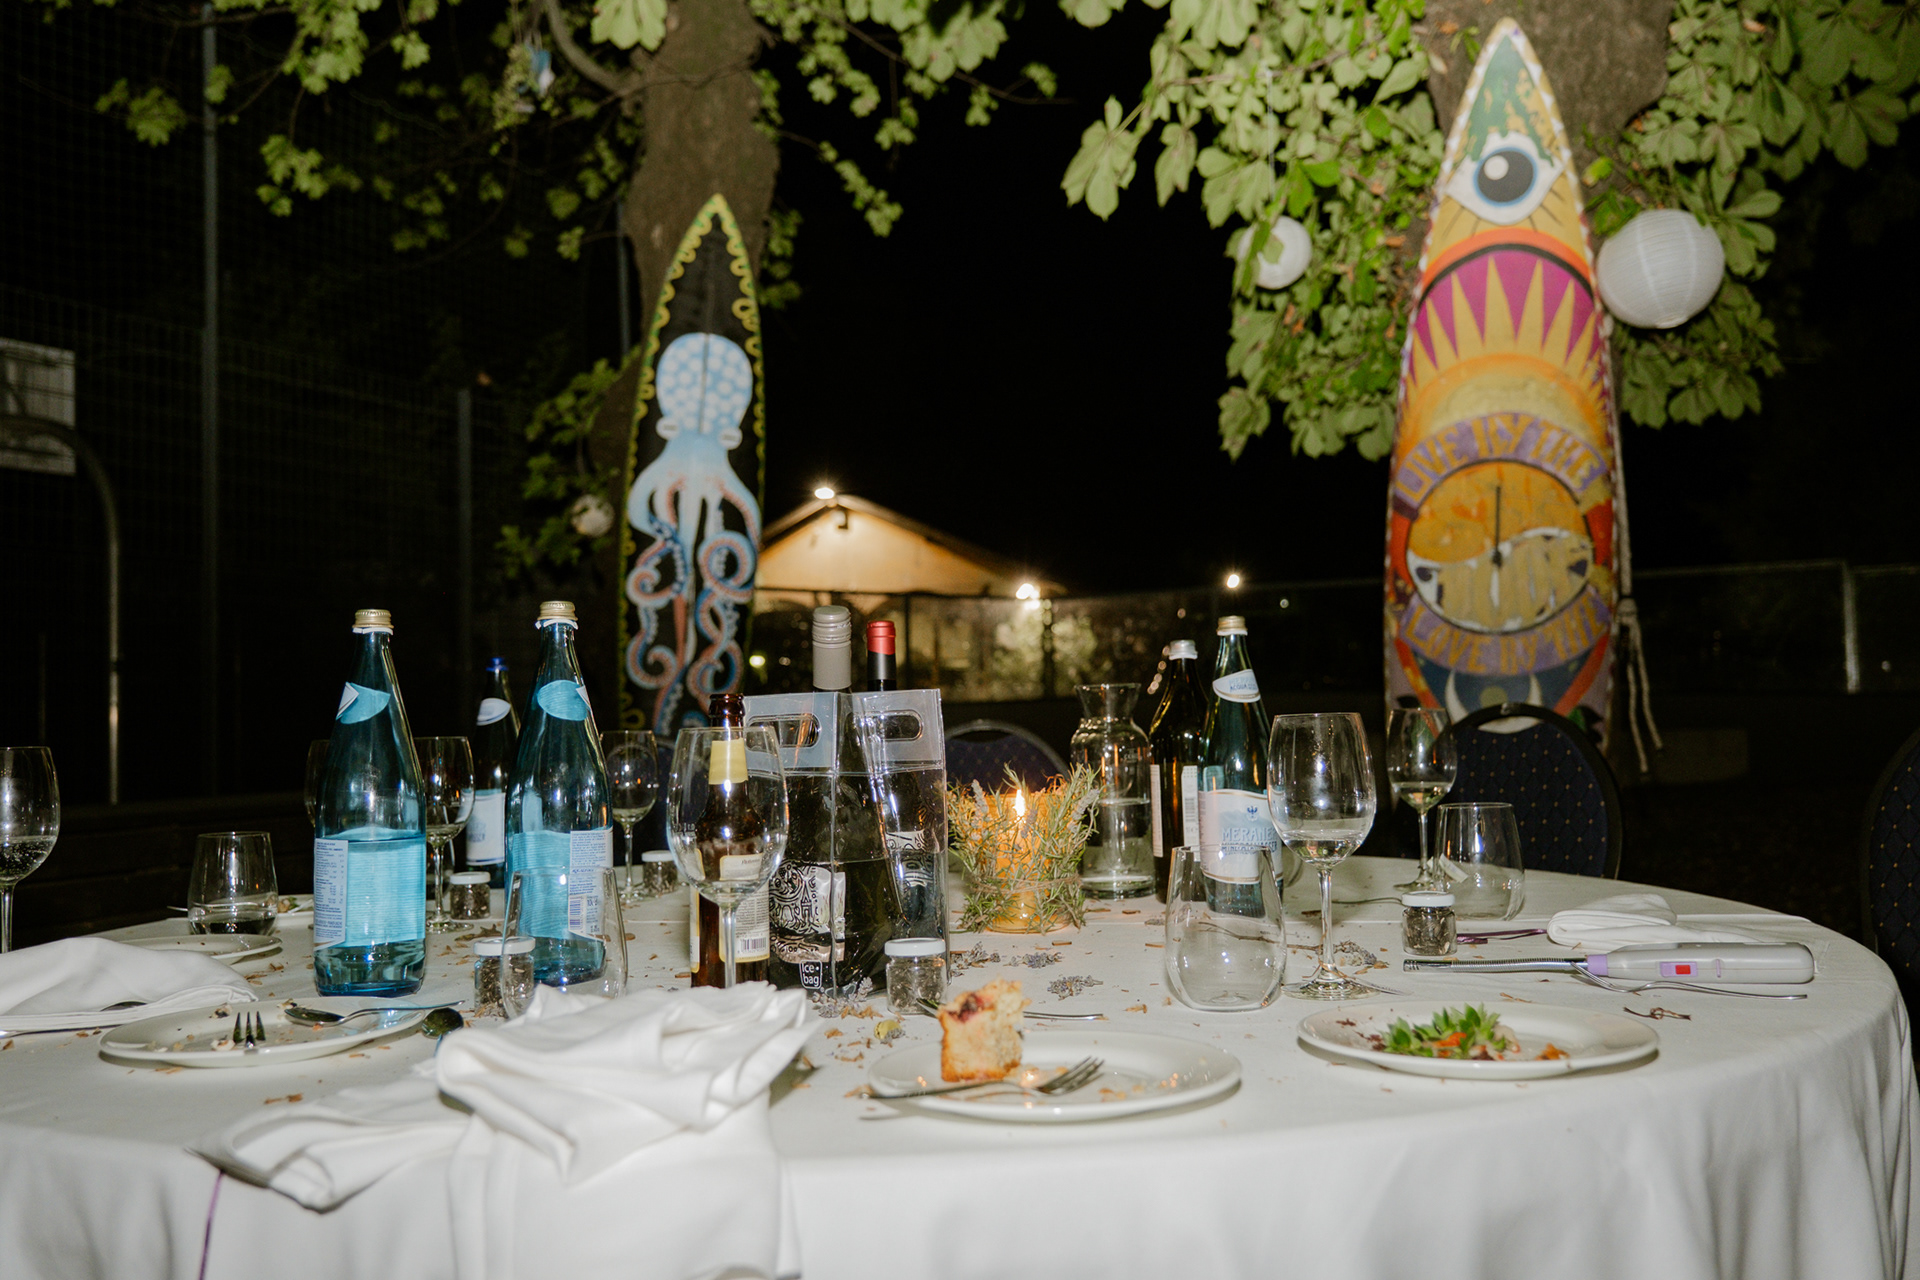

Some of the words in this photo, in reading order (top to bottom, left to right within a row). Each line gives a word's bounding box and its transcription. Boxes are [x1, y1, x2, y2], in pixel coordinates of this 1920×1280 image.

[1394, 426, 1469, 503] LIVE
[1471, 413, 1535, 458] BY
[1530, 420, 1600, 489] THE
[1405, 603, 1493, 674] LOVE
[1499, 634, 1538, 676] BY
[1542, 594, 1605, 662] THE
[802, 972, 819, 987] bag
